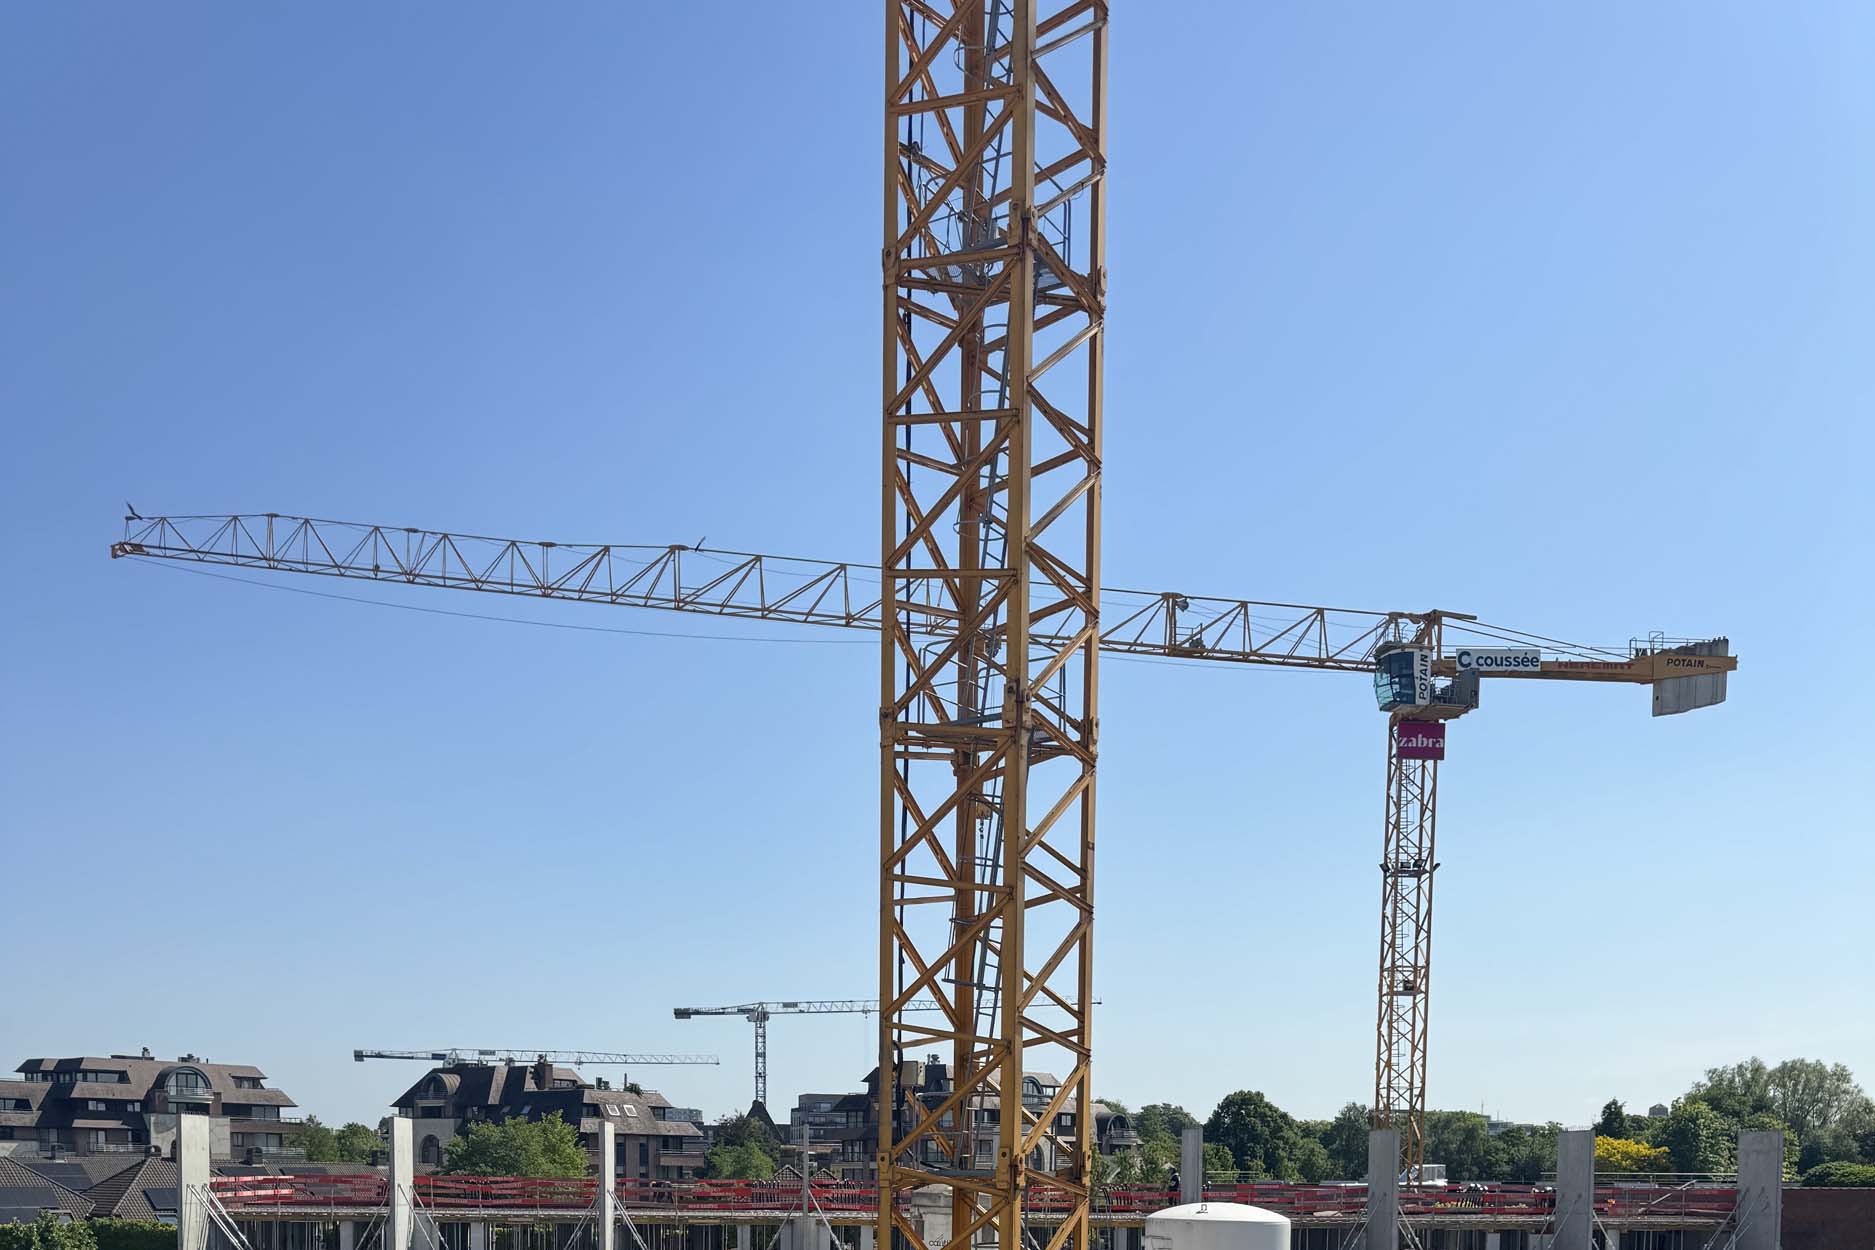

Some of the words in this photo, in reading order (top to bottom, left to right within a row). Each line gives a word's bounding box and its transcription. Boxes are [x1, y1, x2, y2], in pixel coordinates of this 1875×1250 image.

[1475, 651, 1540, 668] coussée
[1666, 658, 1705, 668] POTAIN
[1419, 653, 1429, 700] POTAIN
[1399, 733, 1444, 748] zabra
